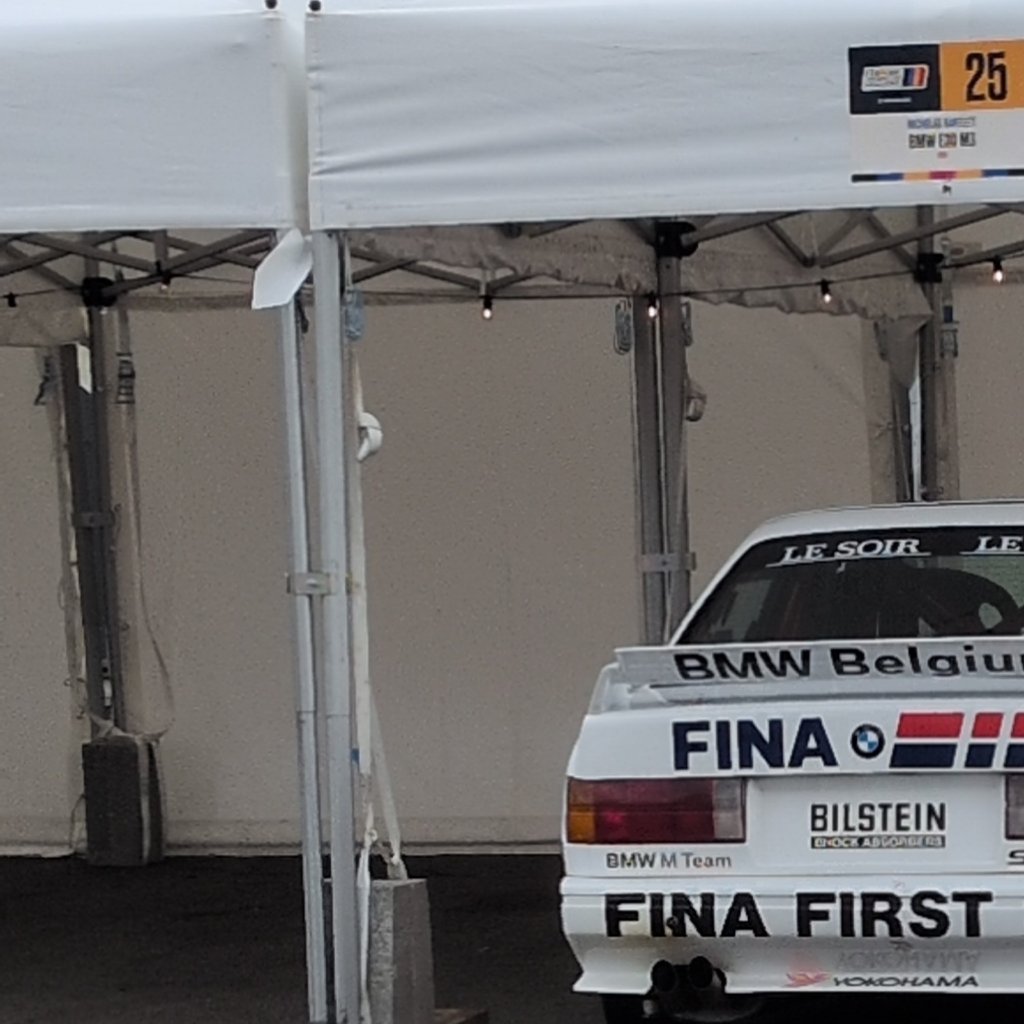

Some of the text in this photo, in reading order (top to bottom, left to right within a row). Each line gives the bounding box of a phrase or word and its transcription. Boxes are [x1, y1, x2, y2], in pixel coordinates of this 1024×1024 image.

[965, 51, 1008, 101] 25
[782, 538, 921, 563] LE SOIR
[976, 535, 1023, 551] LE
[673, 649, 811, 681] BMW
[672, 717, 840, 771] FINA
[810, 802, 946, 832] BILSTEIN
[606, 852, 732, 869] BMW M Team
[604, 892, 771, 938] FINA
[796, 890, 994, 938] FIRST
[833, 975, 980, 988] YOKOHAMA
